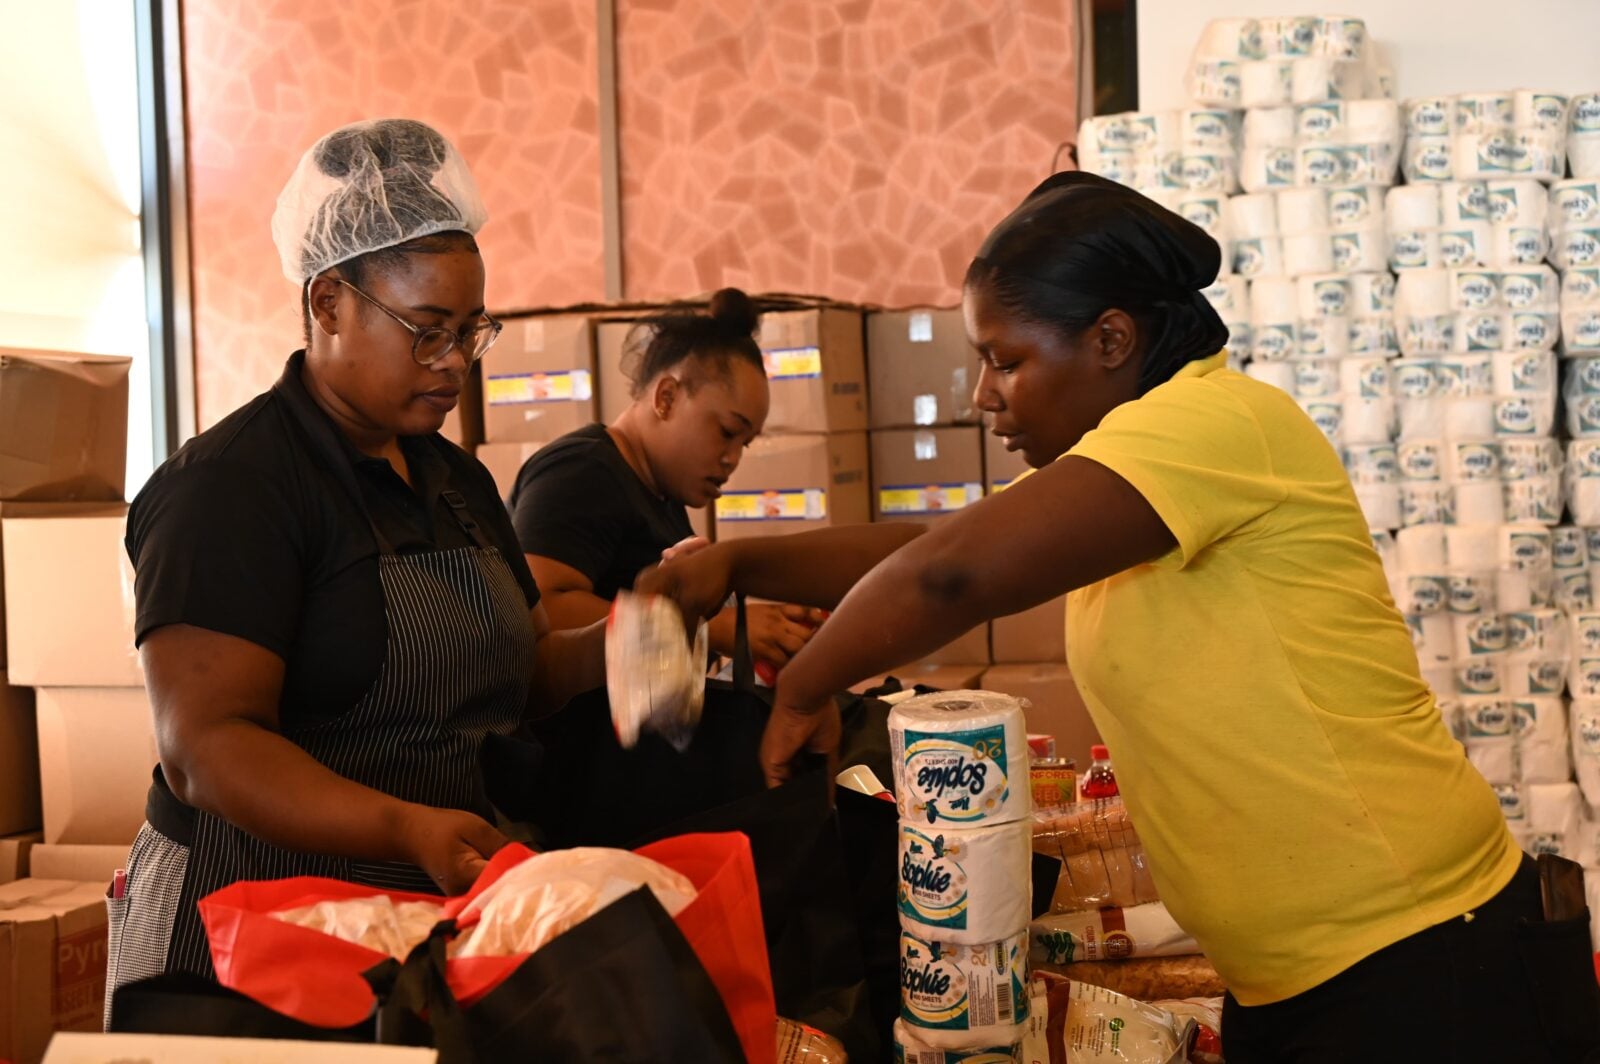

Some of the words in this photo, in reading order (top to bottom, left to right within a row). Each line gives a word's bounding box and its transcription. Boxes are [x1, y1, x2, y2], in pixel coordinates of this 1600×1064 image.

[973, 738, 1002, 761] 20
[917, 756, 987, 798] Sophie
[901, 852, 952, 895] Sophie
[922, 891, 942, 901] SHEETS
[901, 956, 951, 1000] Sophie
[921, 995, 942, 1003] SHEETS
